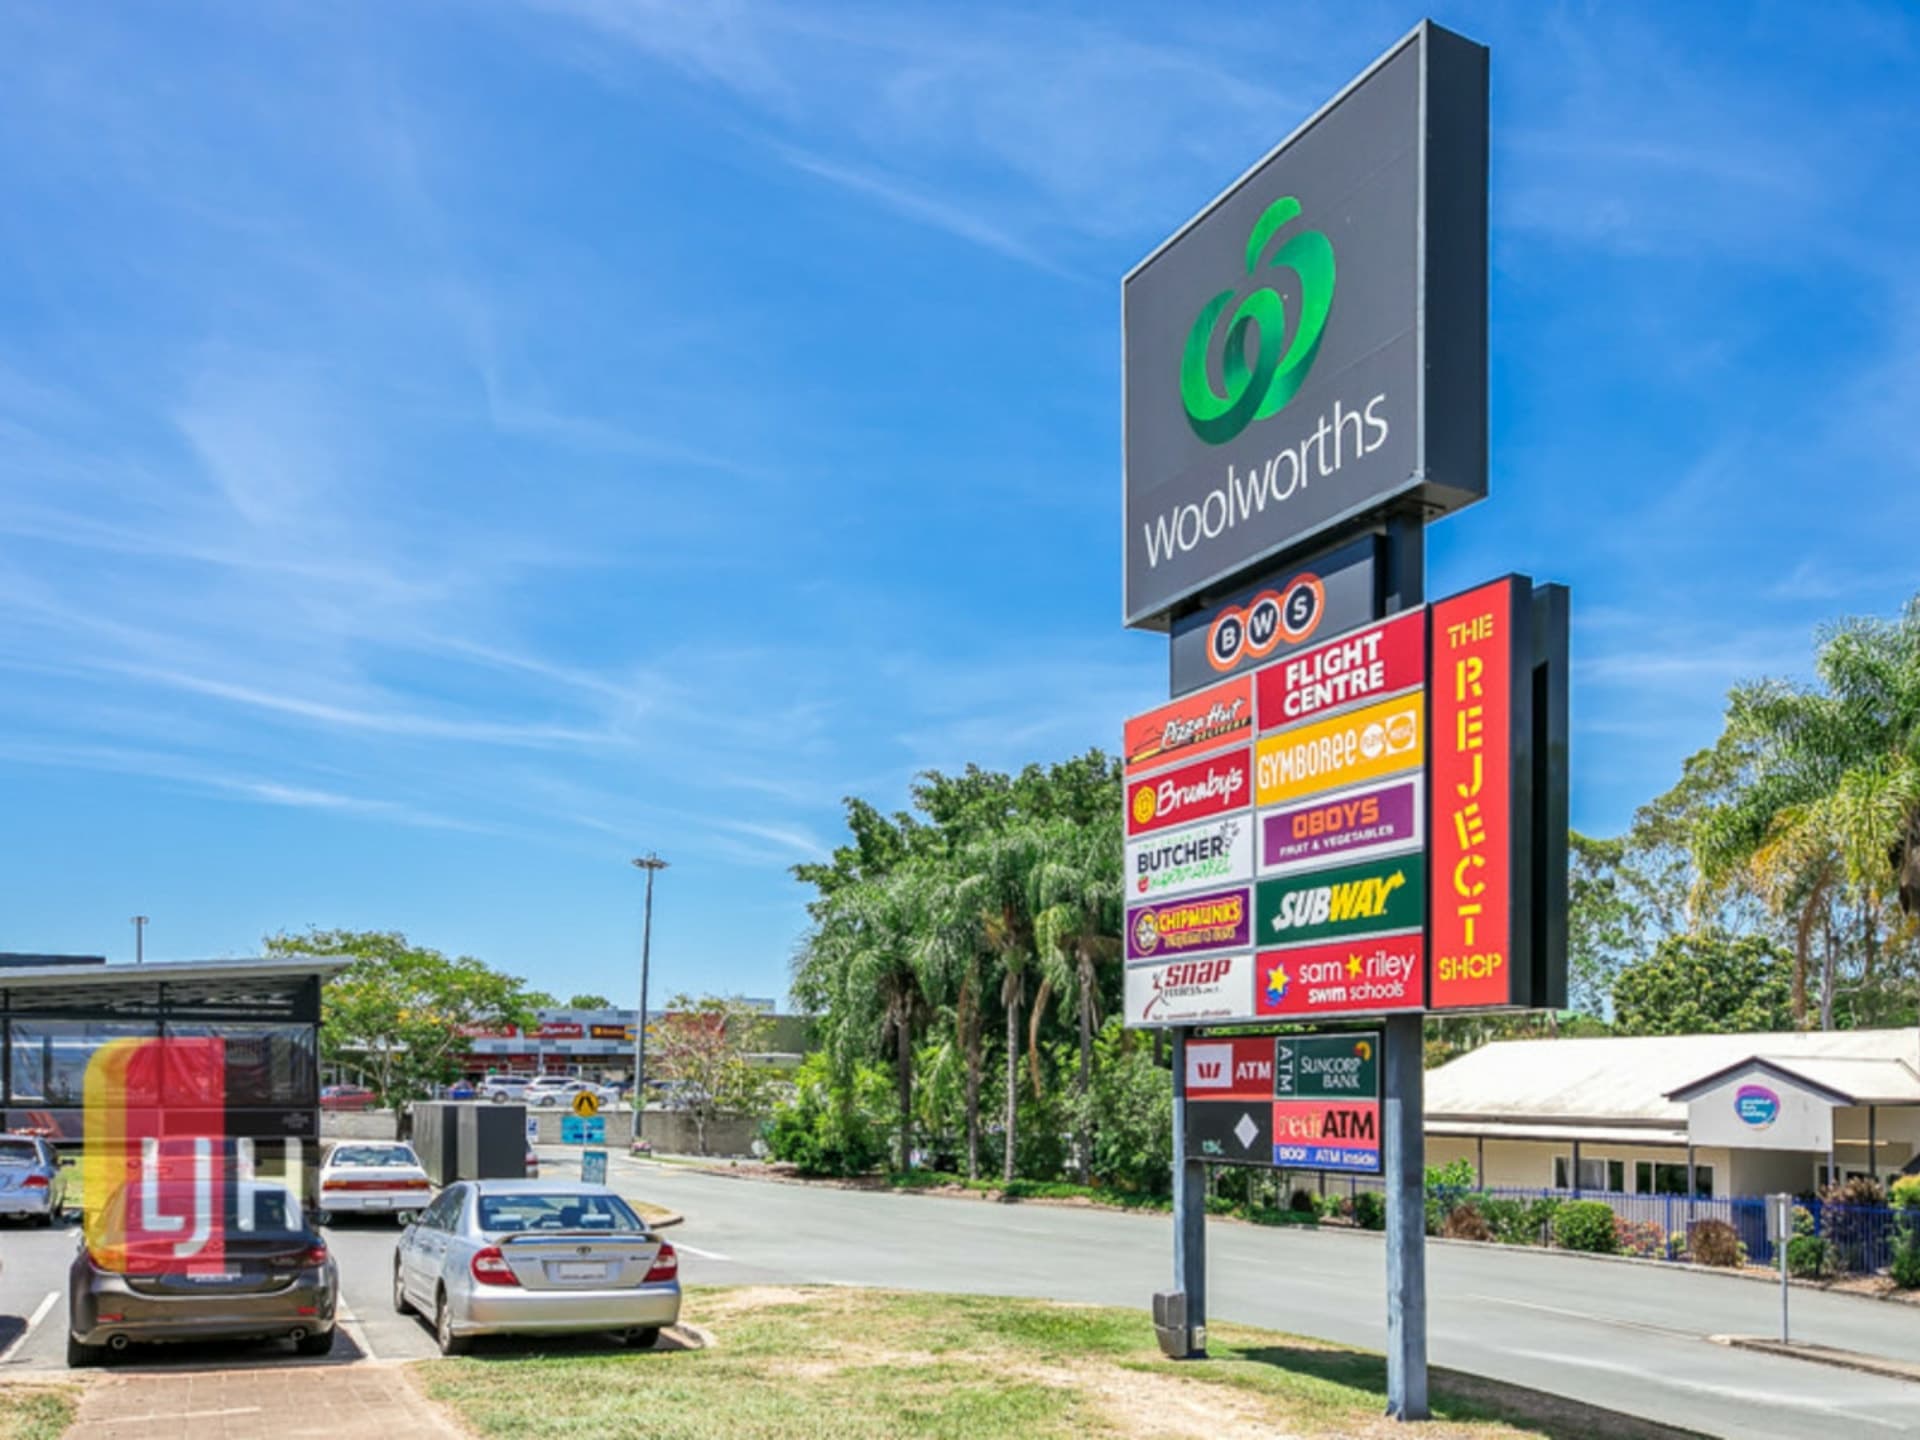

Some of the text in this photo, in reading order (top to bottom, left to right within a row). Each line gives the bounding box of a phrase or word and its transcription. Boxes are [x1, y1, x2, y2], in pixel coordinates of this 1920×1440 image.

[1220, 595, 1309, 652] BWS
[1447, 614, 1493, 648] THE
[1286, 631, 1383, 691] FLIGHT
[1283, 661, 1384, 717] CENTRE
[1292, 797, 1380, 839] OBOYS
[1454, 656, 1486, 946] REJECT
[1138, 835, 1224, 874] BUTCHER
[1272, 869, 1406, 932] SUBWAY
[1299, 949, 1416, 984] sam riley
[1438, 952, 1502, 981] SHOP
[1308, 979, 1404, 1004] swim schools
[1236, 1061, 1271, 1080] ATM
[1279, 1045, 1294, 1092] ATM
[1300, 1055, 1362, 1074] SUNCORP
[1322, 1074, 1361, 1090] BANK
